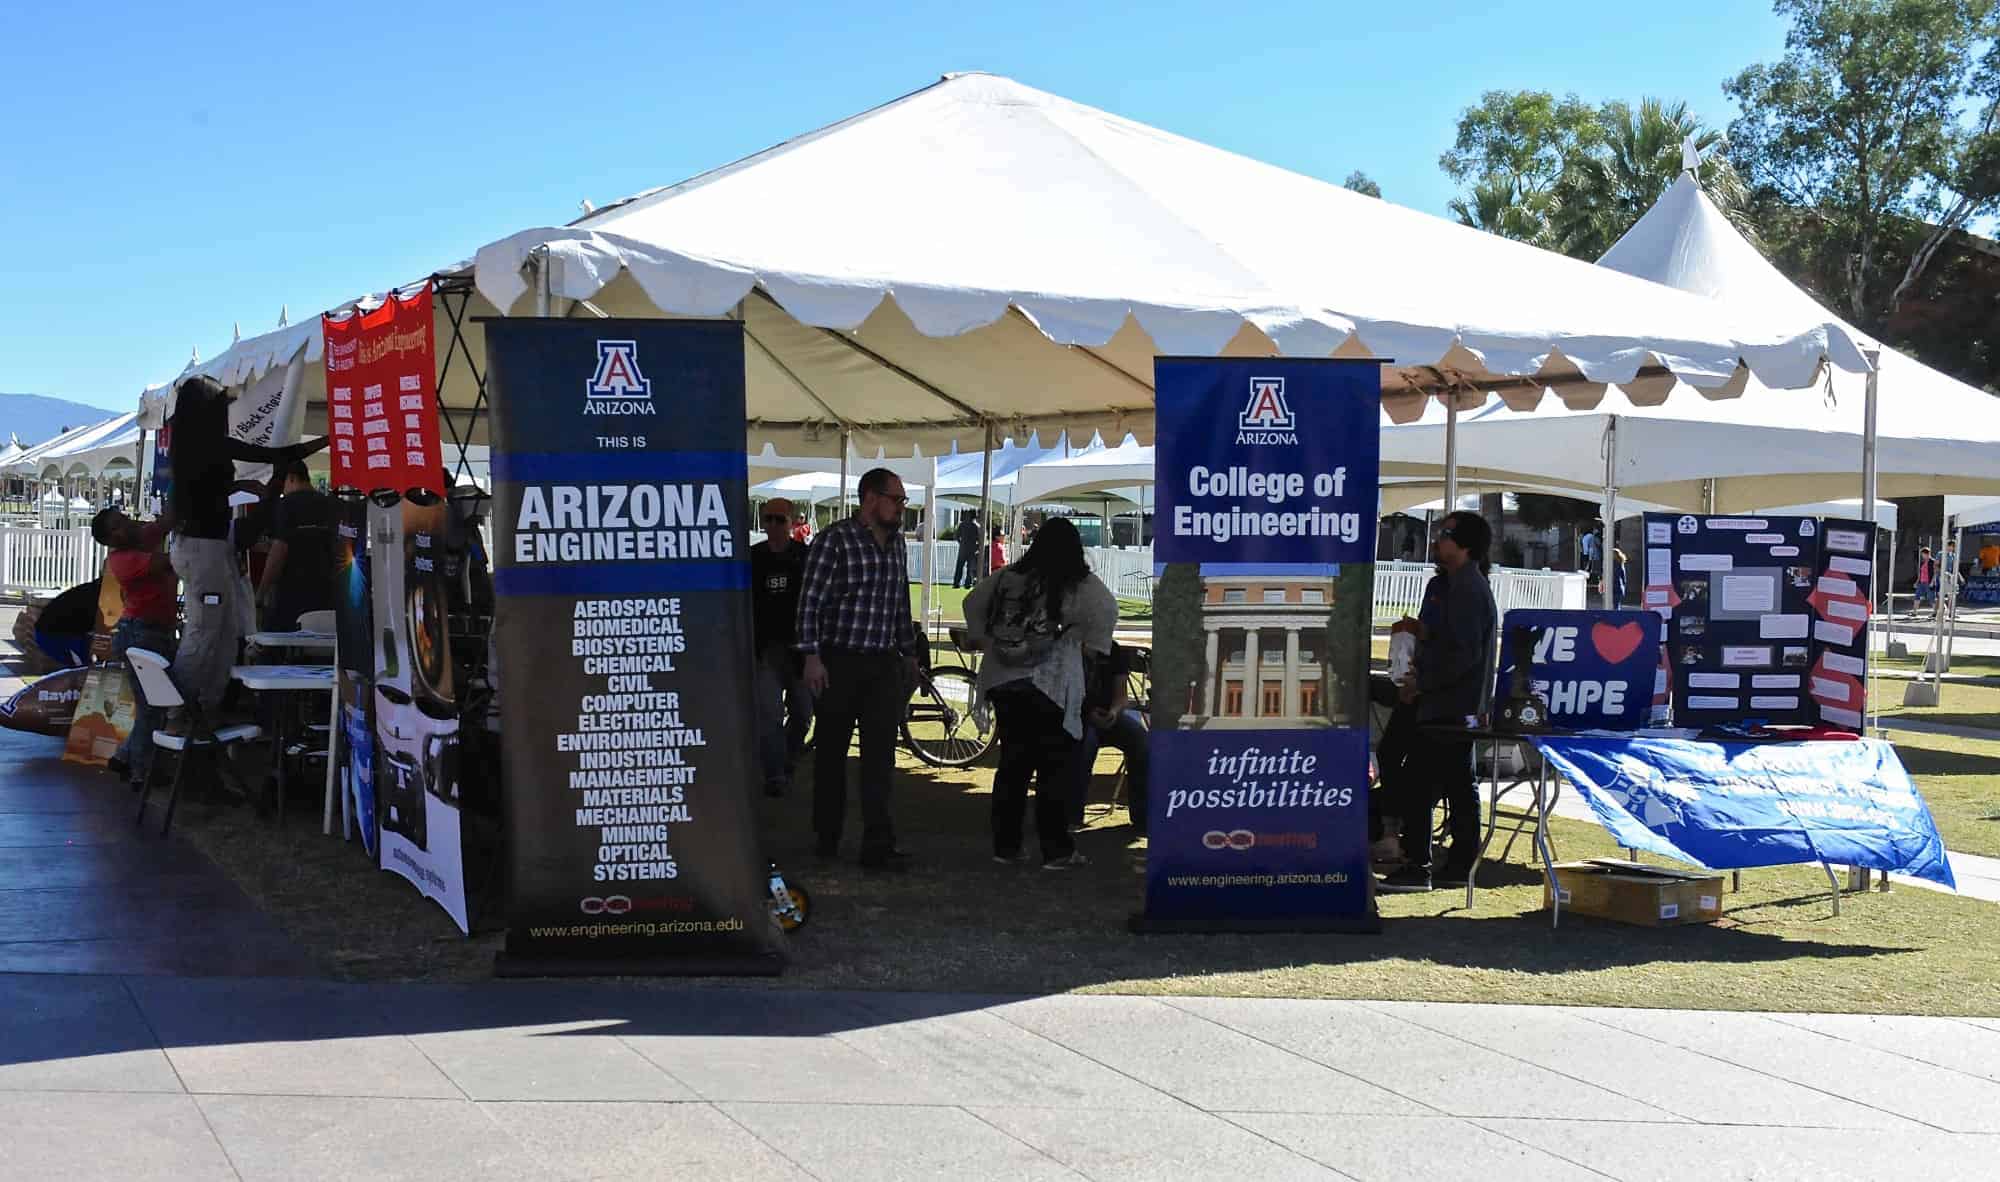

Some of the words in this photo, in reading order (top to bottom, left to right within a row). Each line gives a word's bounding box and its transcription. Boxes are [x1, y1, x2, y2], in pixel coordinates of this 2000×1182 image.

[584, 401, 656, 415] ARIZONA
[236, 414, 264, 434] Black
[596, 437, 628, 448] THIS
[633, 436, 647, 448] IS
[1235, 431, 1298, 445] ARIZONA
[1189, 466, 1304, 503] College
[1313, 467, 1346, 496] of
[517, 484, 729, 530] ARIZONA
[1174, 506, 1360, 543] Engineering
[515, 529, 733, 562] ENGINEERING
[574, 598, 681, 618] AEROSPACE
[574, 617, 682, 637] BIOMEDICAL
[573, 636, 685, 656] BIOSYSTEMS
[584, 654, 675, 675] CHEMICAL
[608, 674, 653, 692] CIVIL
[581, 693, 679, 713] COMPUTER
[579, 712, 684, 732] ELECTRICAL
[557, 729, 706, 751] ENVIRONMENTAL
[580, 749, 685, 769] INDUSTRIAL
[1207, 747, 1317, 783] infinite
[569, 767, 696, 789] MANAGEMENT
[583, 786, 683, 807] MATERIALS
[1166, 780, 1353, 817] possibilities
[576, 805, 692, 826] MECHANICAL
[602, 825, 667, 843] MINING
[598, 843, 672, 863] OPTICAL
[594, 862, 678, 881] SYSTEMS
[1168, 871, 1348, 888] www.engineering.arizona.edu
[530, 918, 744, 939] www.engineering.arizona.edu
